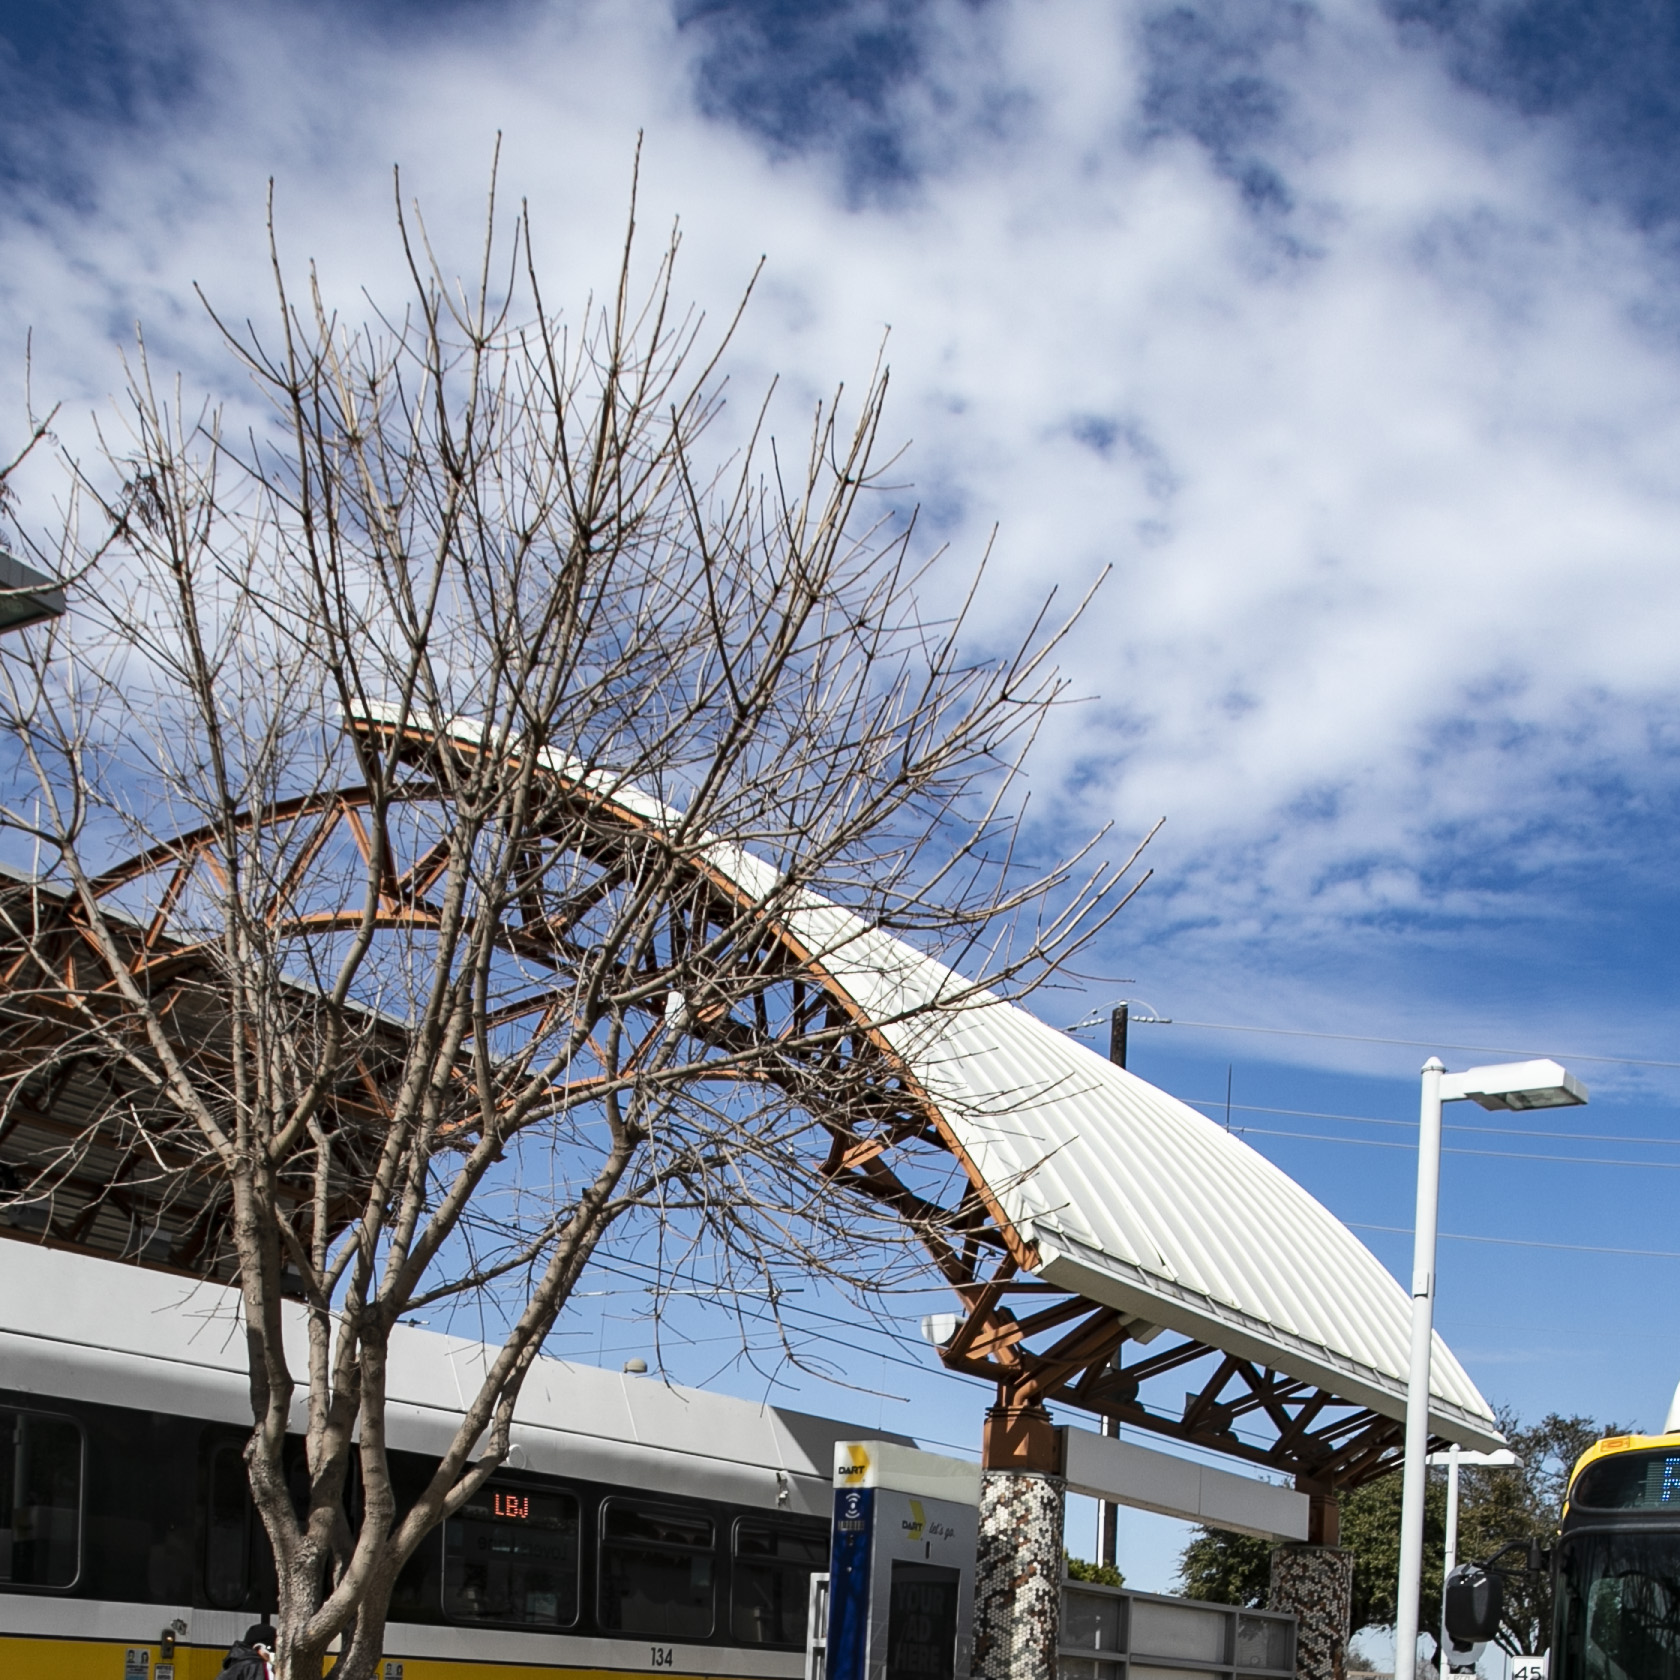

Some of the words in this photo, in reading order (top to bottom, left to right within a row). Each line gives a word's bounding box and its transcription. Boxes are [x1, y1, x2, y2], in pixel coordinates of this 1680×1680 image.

[838, 1465, 865, 1475] DART
[494, 1493, 529, 1519] LBJ
[901, 1520, 924, 1532] DART
[650, 1646, 673, 1667] 134
